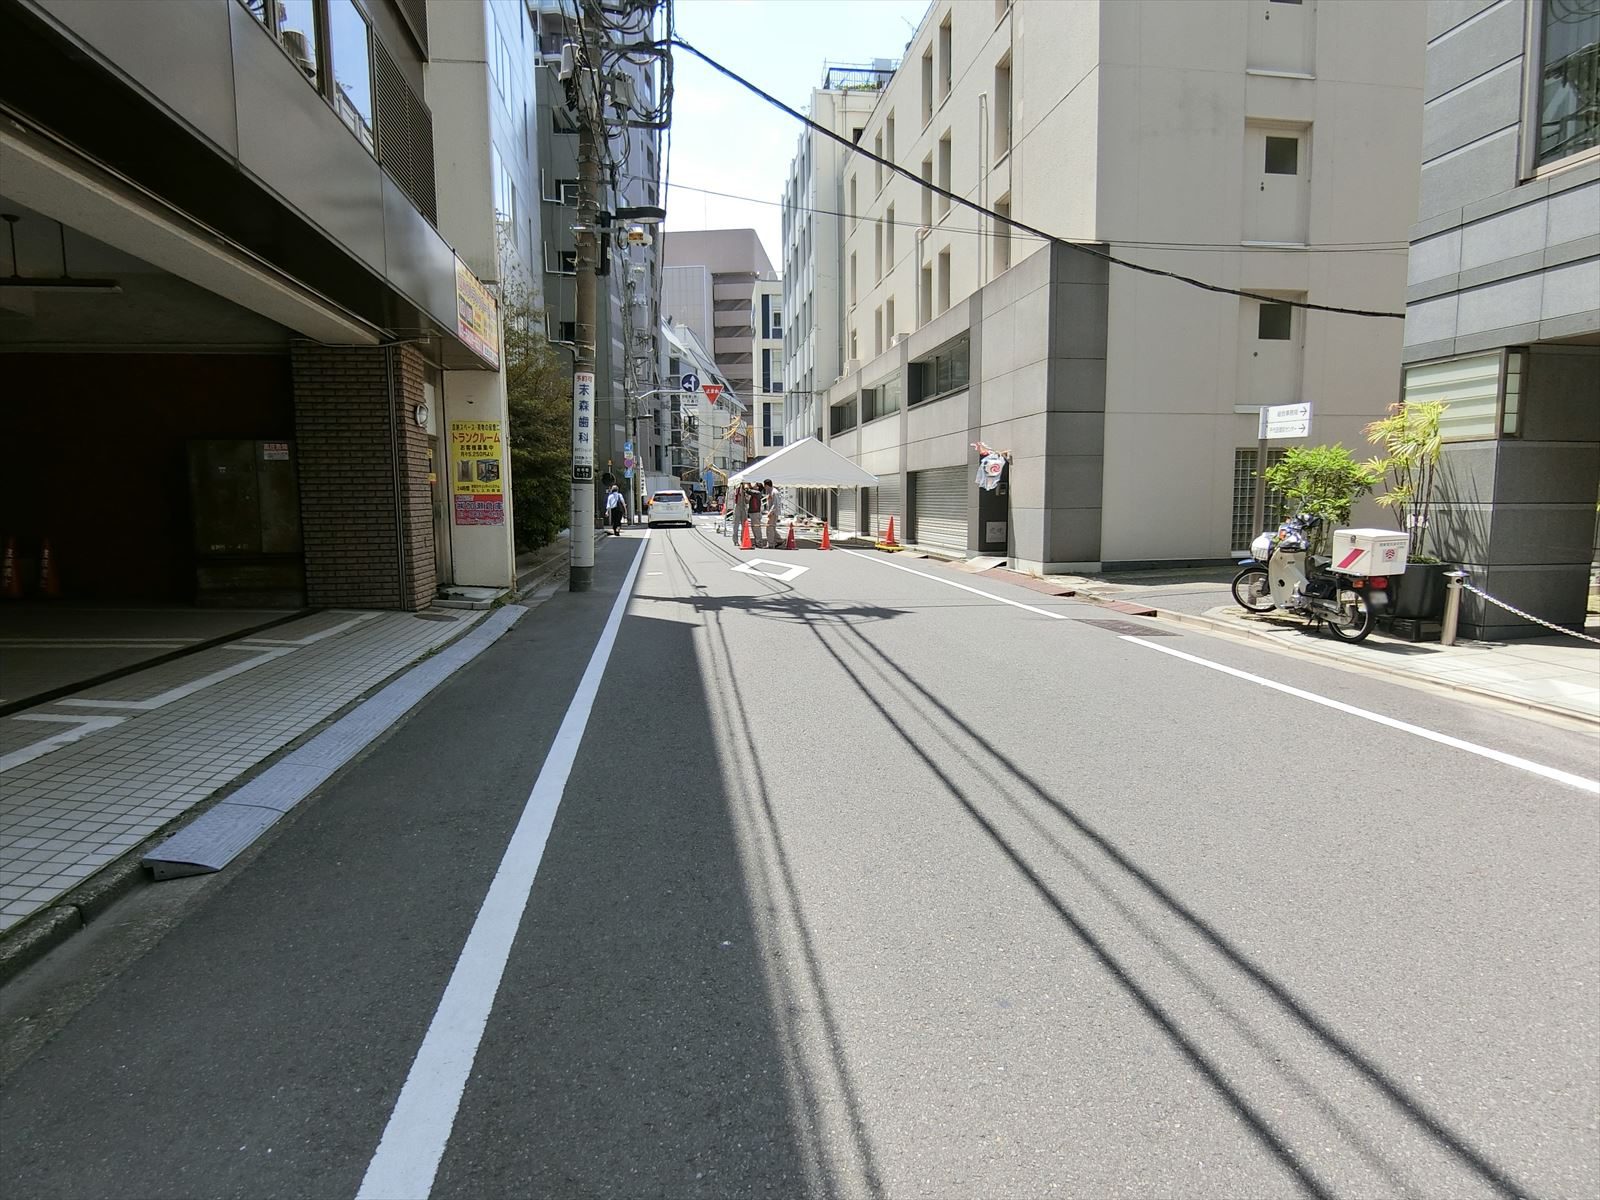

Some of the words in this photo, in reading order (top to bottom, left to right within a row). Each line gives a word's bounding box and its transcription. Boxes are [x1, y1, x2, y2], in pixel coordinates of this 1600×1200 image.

[452, 432, 501, 444] トランクルーム
